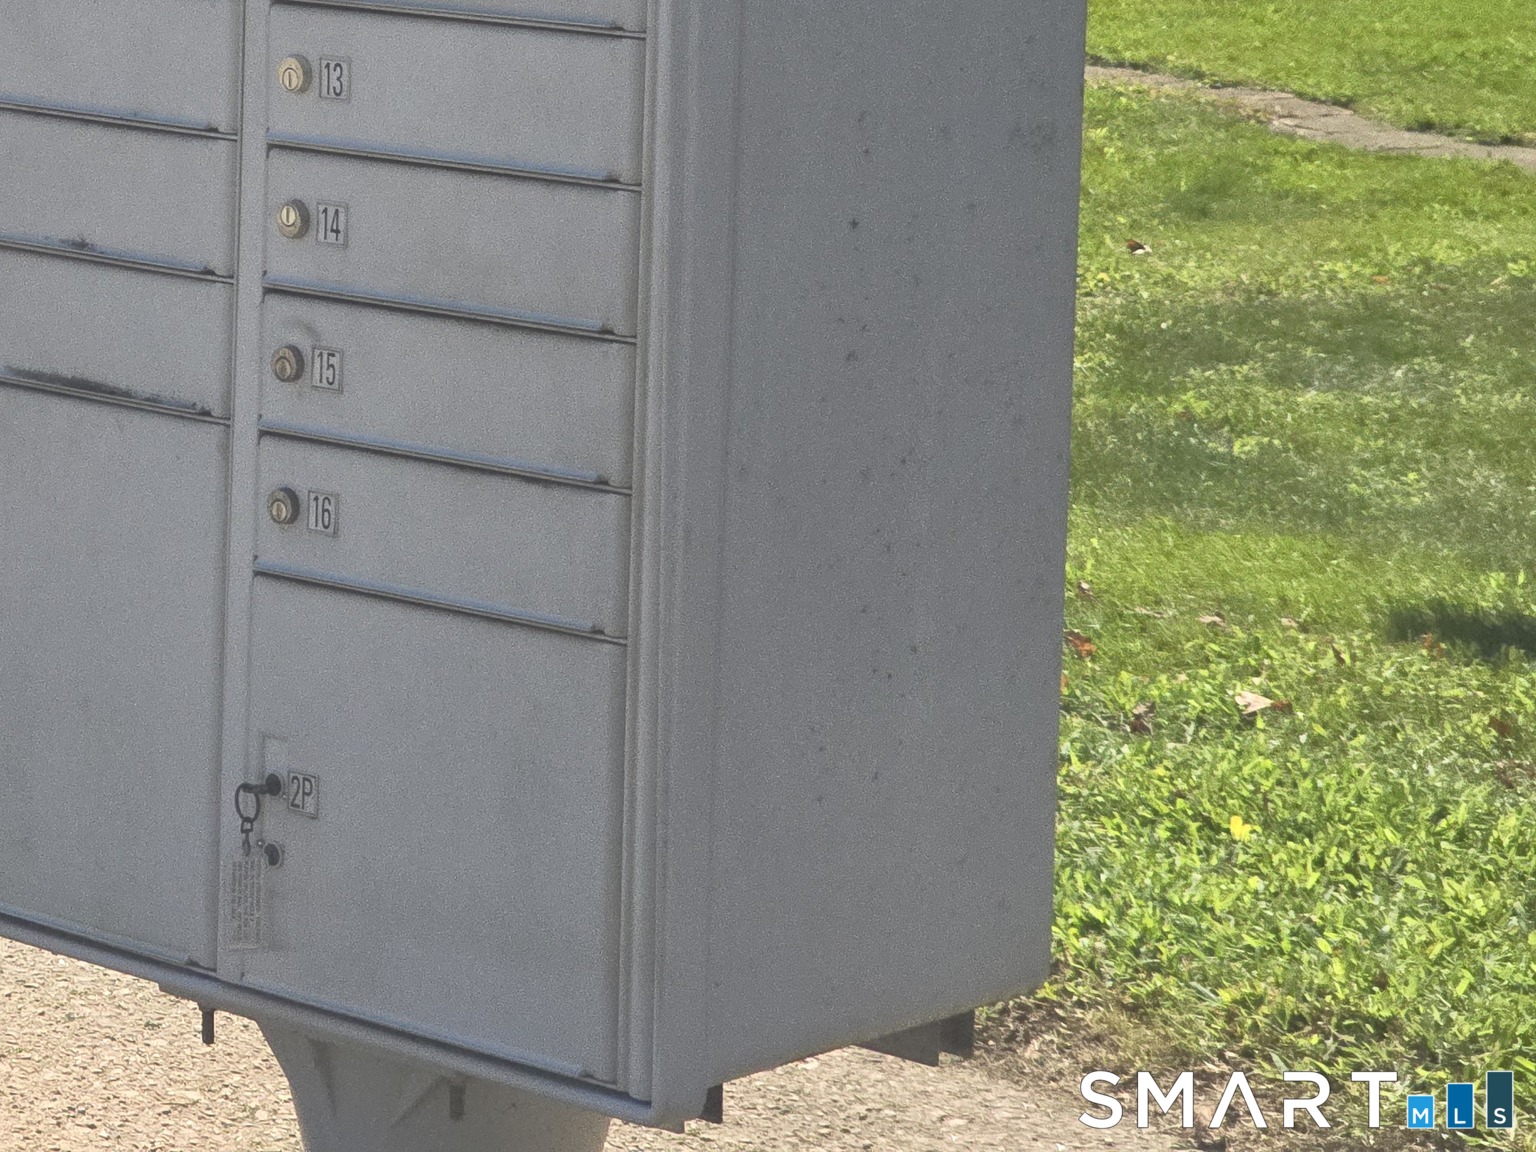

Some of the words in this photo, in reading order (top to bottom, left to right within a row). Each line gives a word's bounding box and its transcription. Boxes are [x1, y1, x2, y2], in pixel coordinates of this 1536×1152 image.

[324, 62, 343, 97] 13
[321, 207, 341, 241] 14
[317, 351, 335, 386] 15
[313, 495, 331, 530] 16
[290, 775, 313, 809] 2P
